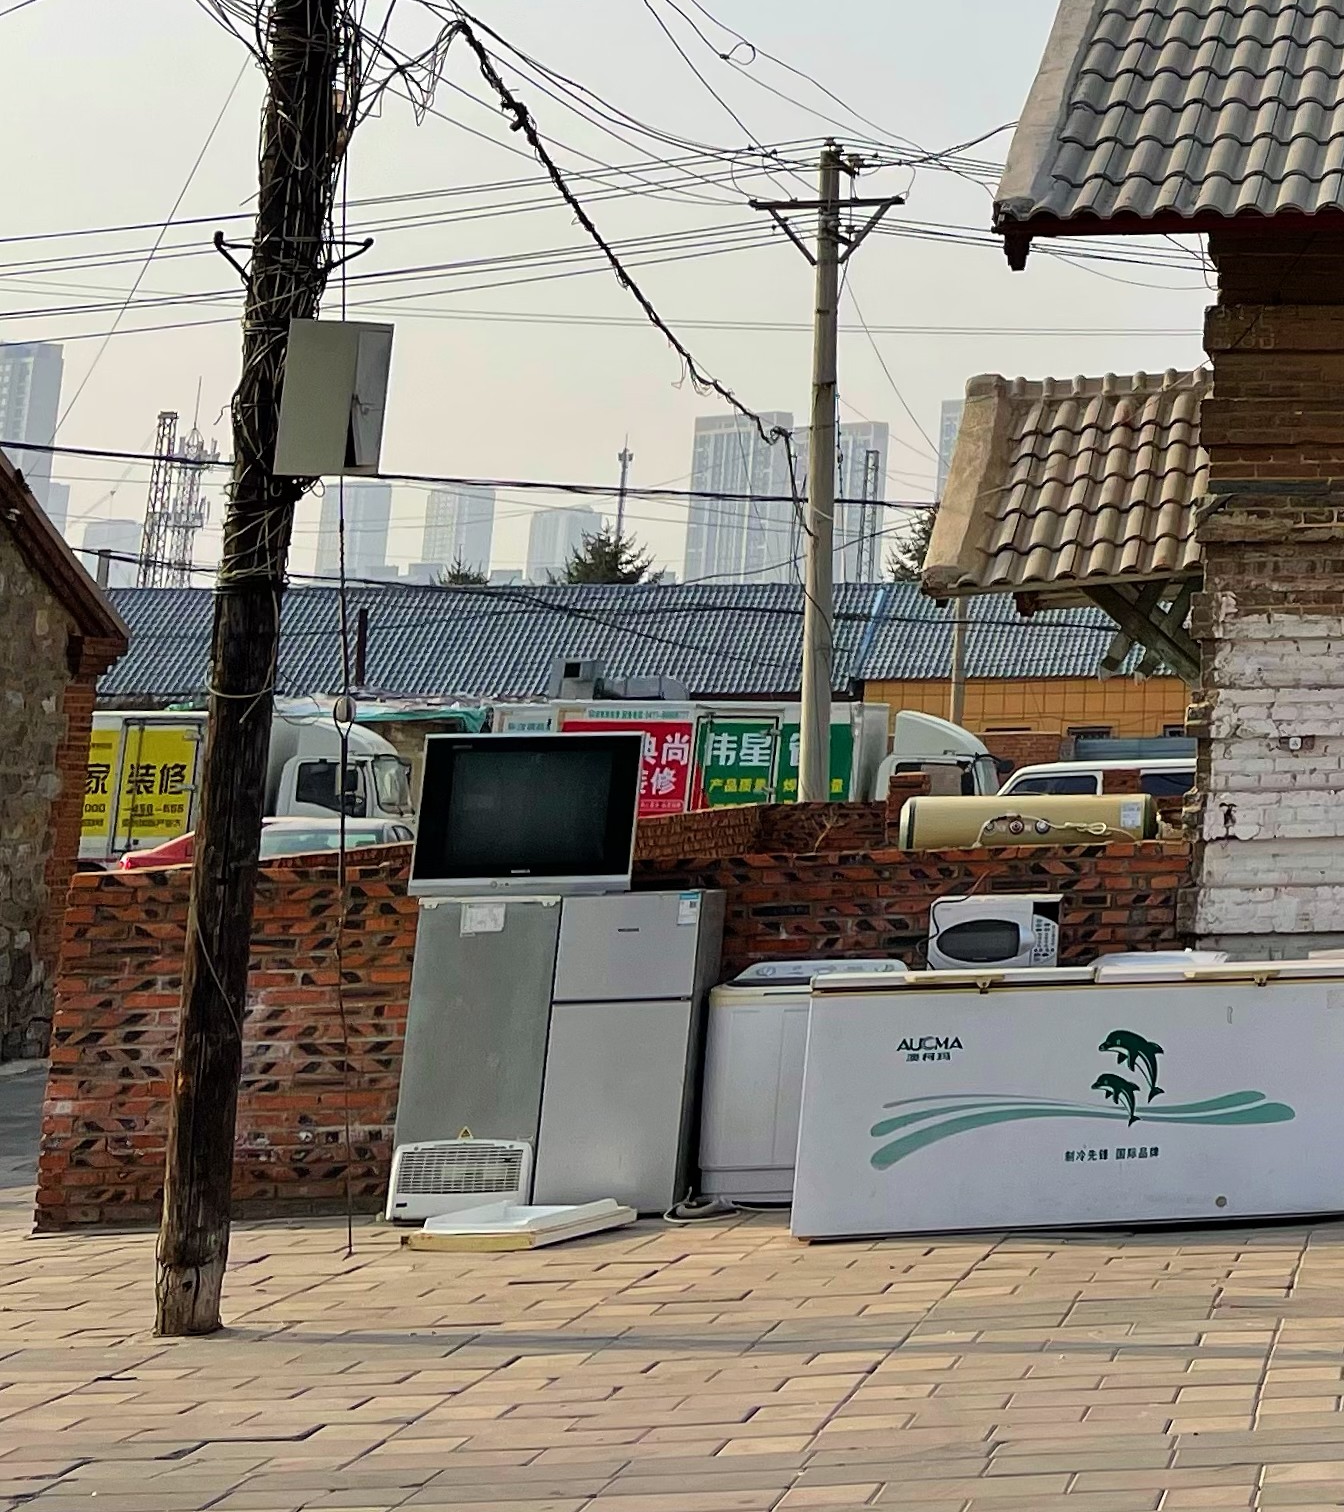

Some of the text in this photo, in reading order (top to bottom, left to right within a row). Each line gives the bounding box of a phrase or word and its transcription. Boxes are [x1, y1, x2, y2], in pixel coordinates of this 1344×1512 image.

[705, 732, 772, 766] 伟星
[896, 1036, 963, 1051] AUCMA
[1064, 1146, 1159, 1162] 制冷先锋 国际品牌
